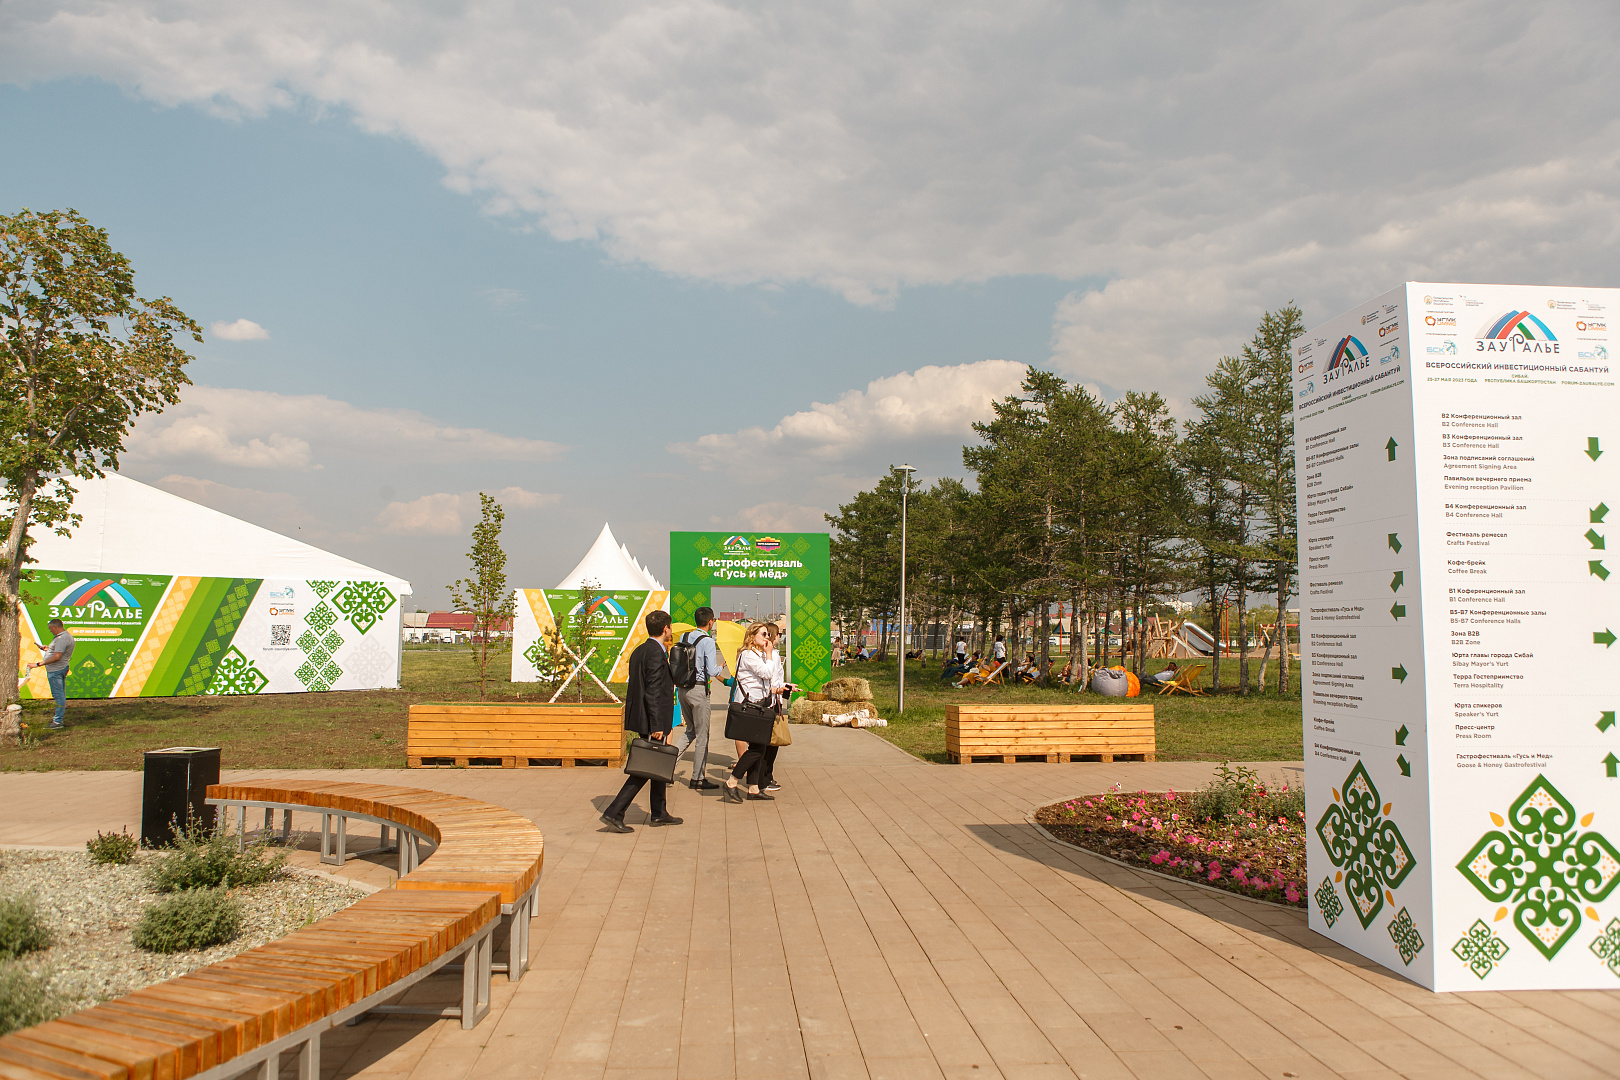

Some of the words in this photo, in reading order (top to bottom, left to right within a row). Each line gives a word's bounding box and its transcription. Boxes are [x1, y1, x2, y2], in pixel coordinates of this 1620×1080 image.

[1476, 334, 1560, 353] ЗАУРАЛЬЕ
[1323, 357, 1370, 384] ЗАУРАЛЬЕ
[1426, 362, 1492, 370] ВСЕРОССИЙСКИЙ
[1494, 363, 1567, 372] ИНВЕСТИЦИОННЫЙ
[1569, 365, 1609, 373] САБАНТУЙ
[1299, 392, 1332, 410] ВСЕРОССИЙСКИЙ
[1332, 376, 1374, 397] ИНВЕСТИЦИОННЫЙ
[1375, 365, 1400, 381] САБАНТУЙ
[702, 557, 803, 569] Гастрофестиваль
[714, 569, 746, 580] «Гусь
[759, 569, 788, 579] мёд»
[49, 600, 142, 619] ЗАУРАЛЬЕ
